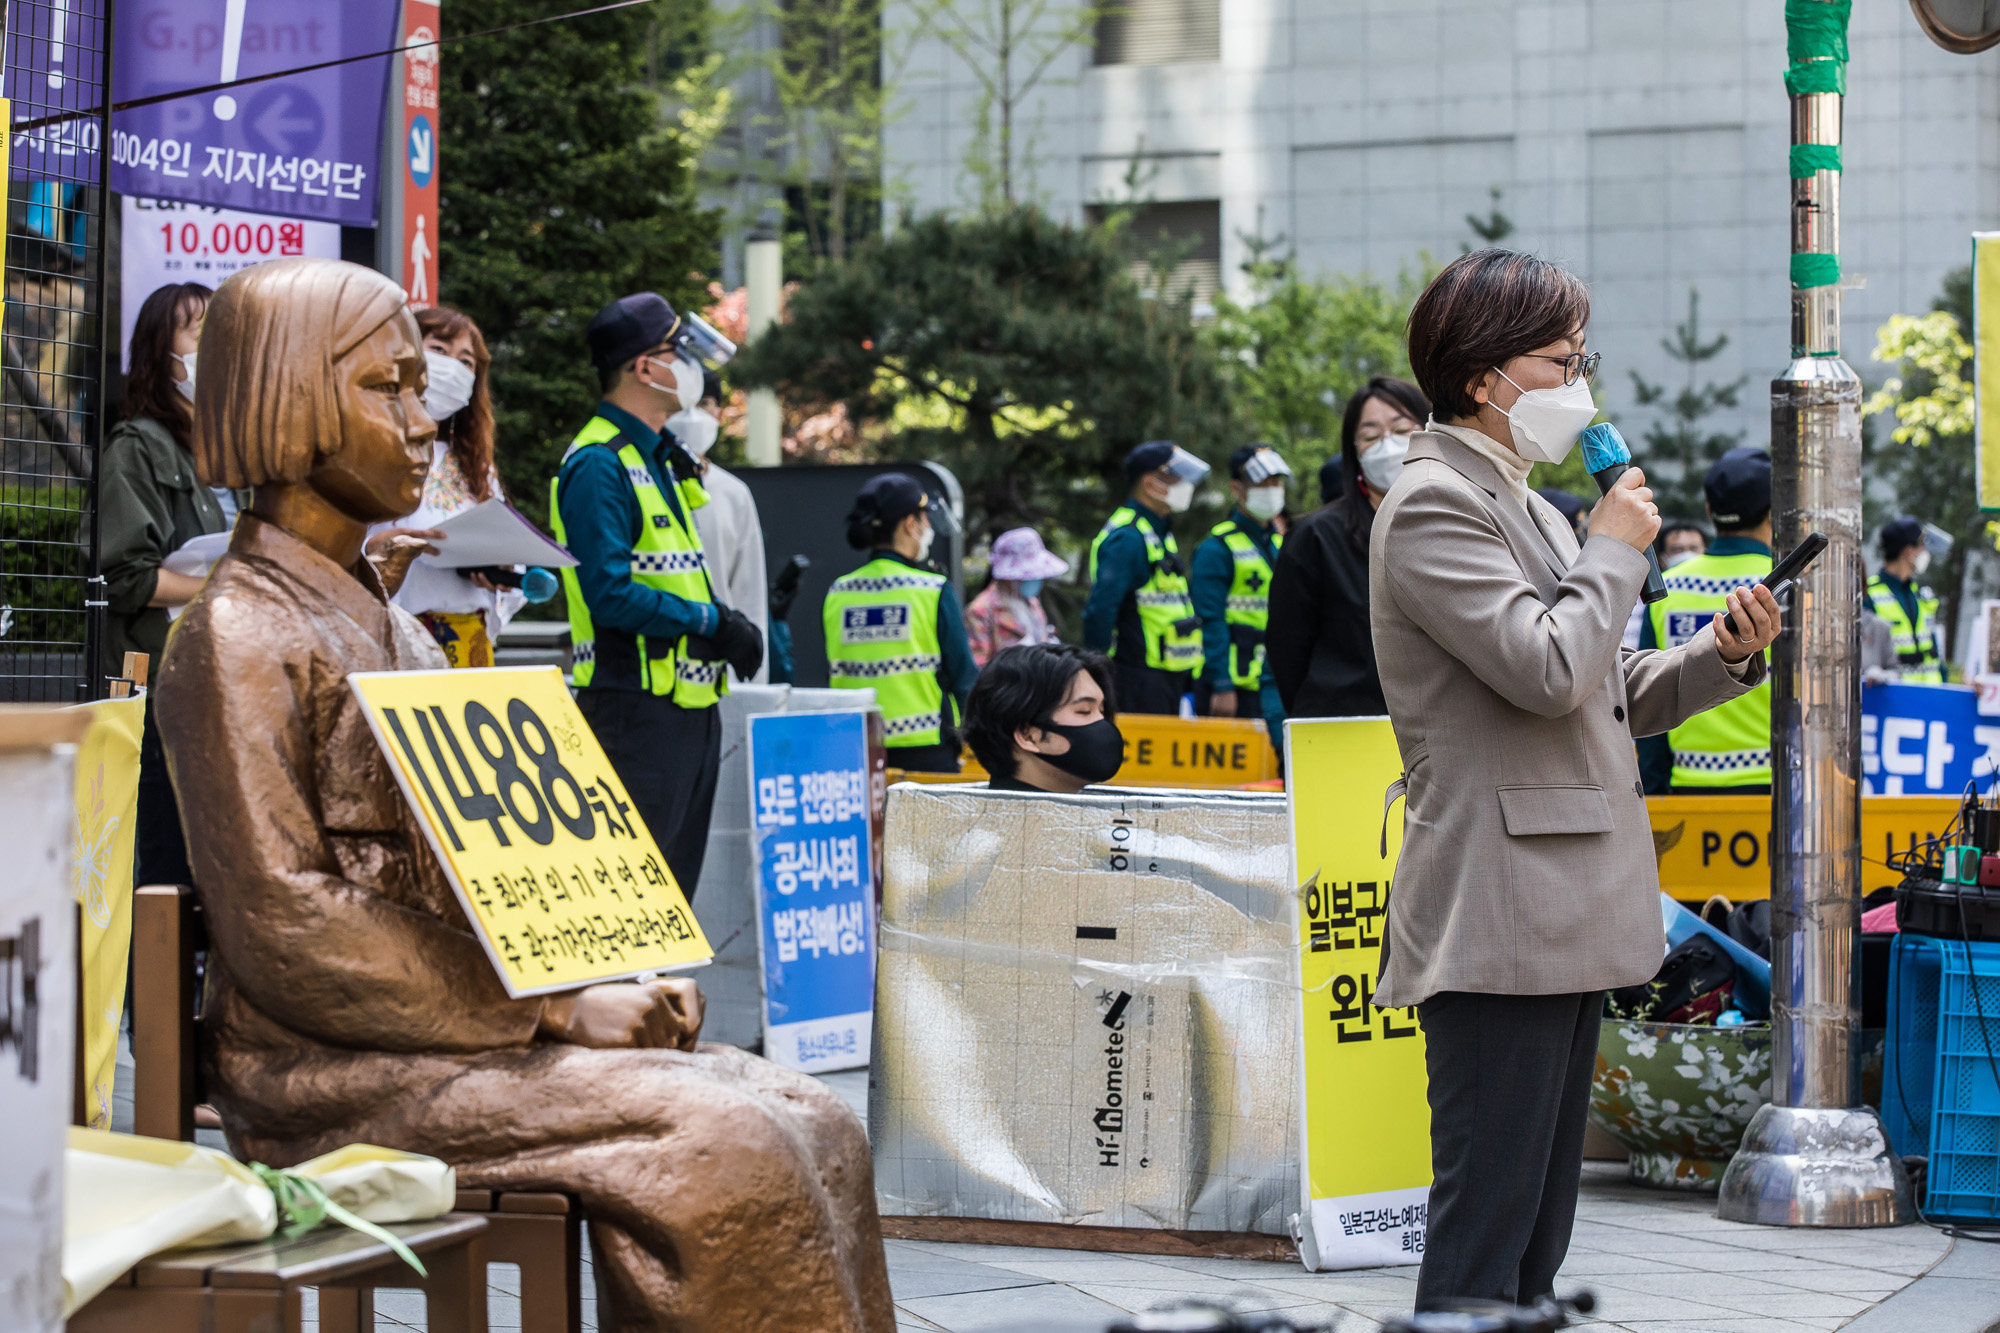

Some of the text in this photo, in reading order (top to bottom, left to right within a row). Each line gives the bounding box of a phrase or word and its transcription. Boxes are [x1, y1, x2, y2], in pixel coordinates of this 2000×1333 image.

[140, 9, 325, 66] G.pant
[111, 129, 192, 178] 1004인
[202, 145, 367, 200] 지지선언단
[160, 221, 304, 258] 10,000원
[381, 698, 637, 852] 1488차
[1172, 740, 1248, 770] LINE
[758, 773, 798, 827] 모든
[800, 766, 867, 825] 전쟁범죄
[773, 834, 860, 896] 공식사죄
[1703, 830, 1771, 868] PO
[1093, 1013, 1125, 1167] Hi-hometec
[1339, 1203, 1428, 1236] 일본군성노예제
